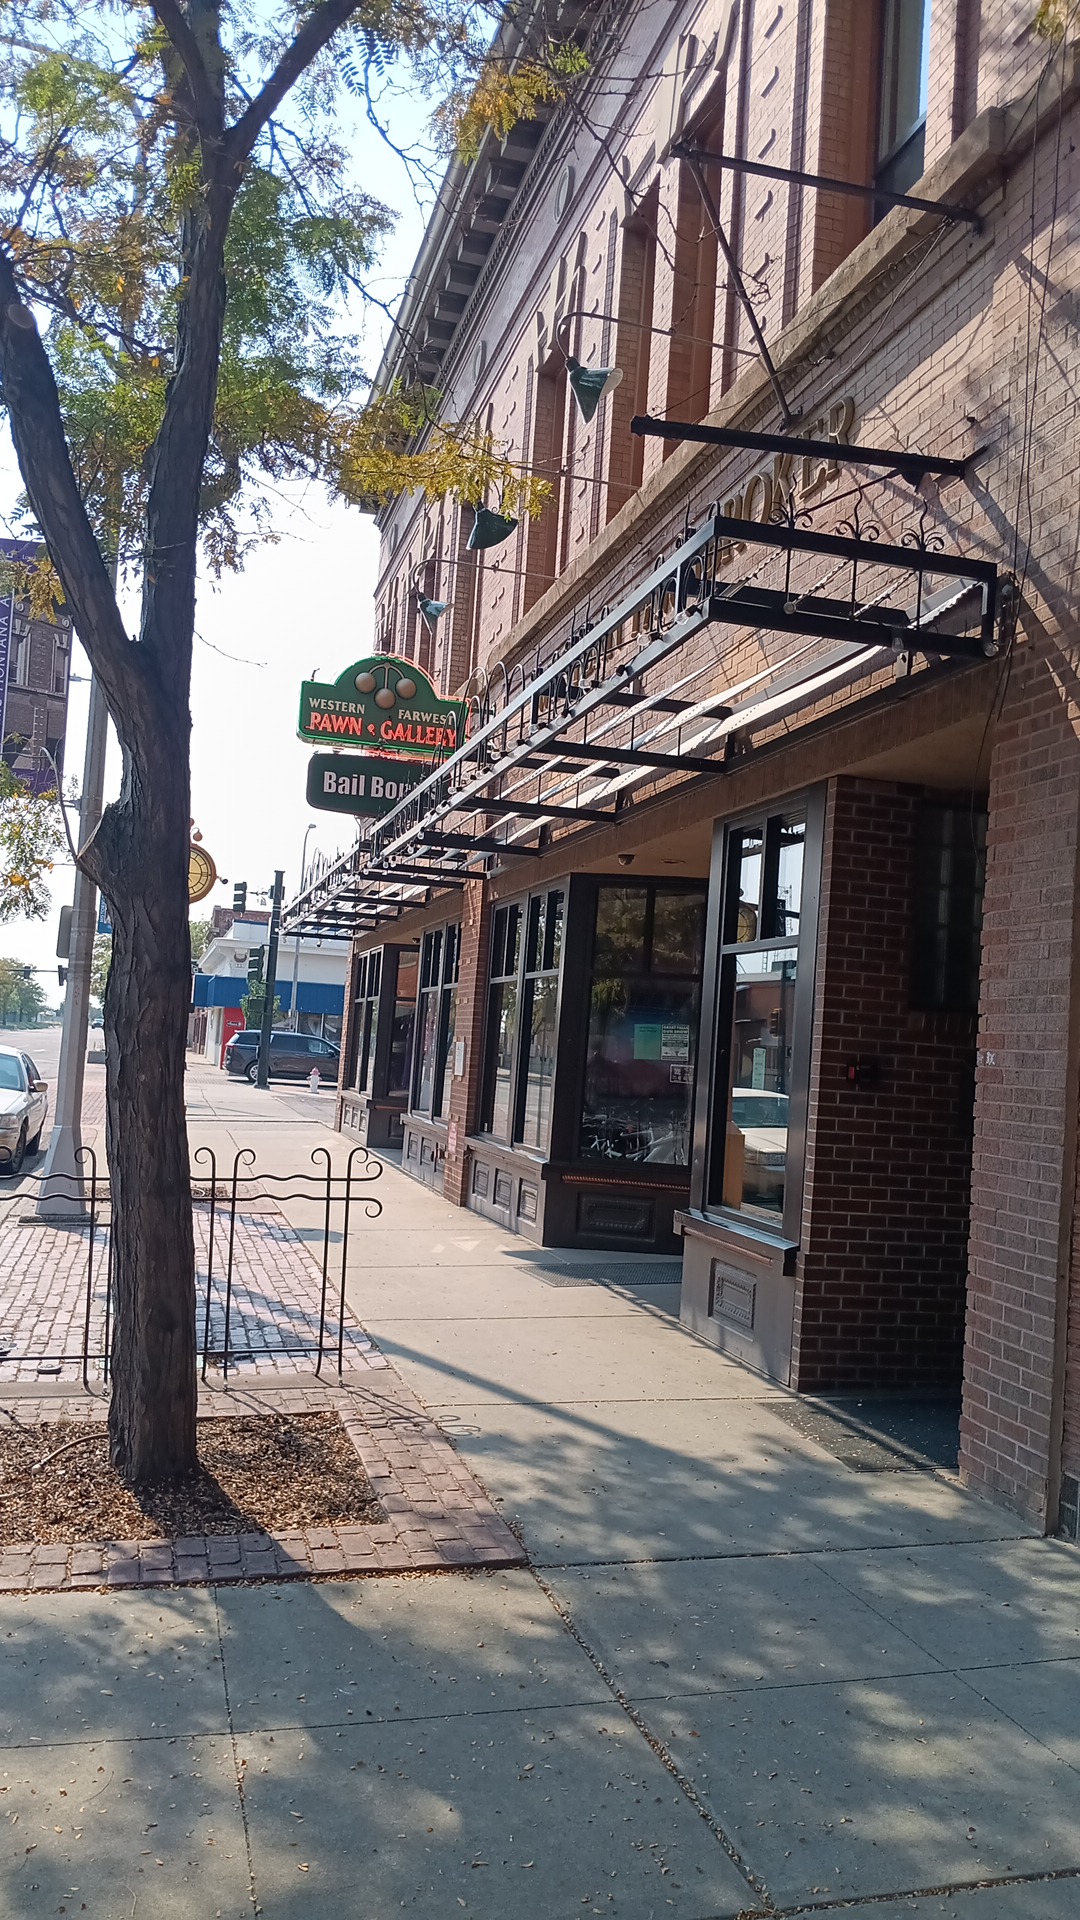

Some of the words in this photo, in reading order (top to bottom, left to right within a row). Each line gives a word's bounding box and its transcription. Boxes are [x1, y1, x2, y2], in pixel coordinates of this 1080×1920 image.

[309, 697, 365, 714] WESTERN
[398, 709, 455, 726] FARWEST
[305, 712, 363, 736] PAWN
[380, 720, 457, 747] GALLERY
[323, 770, 366, 796] Bail
